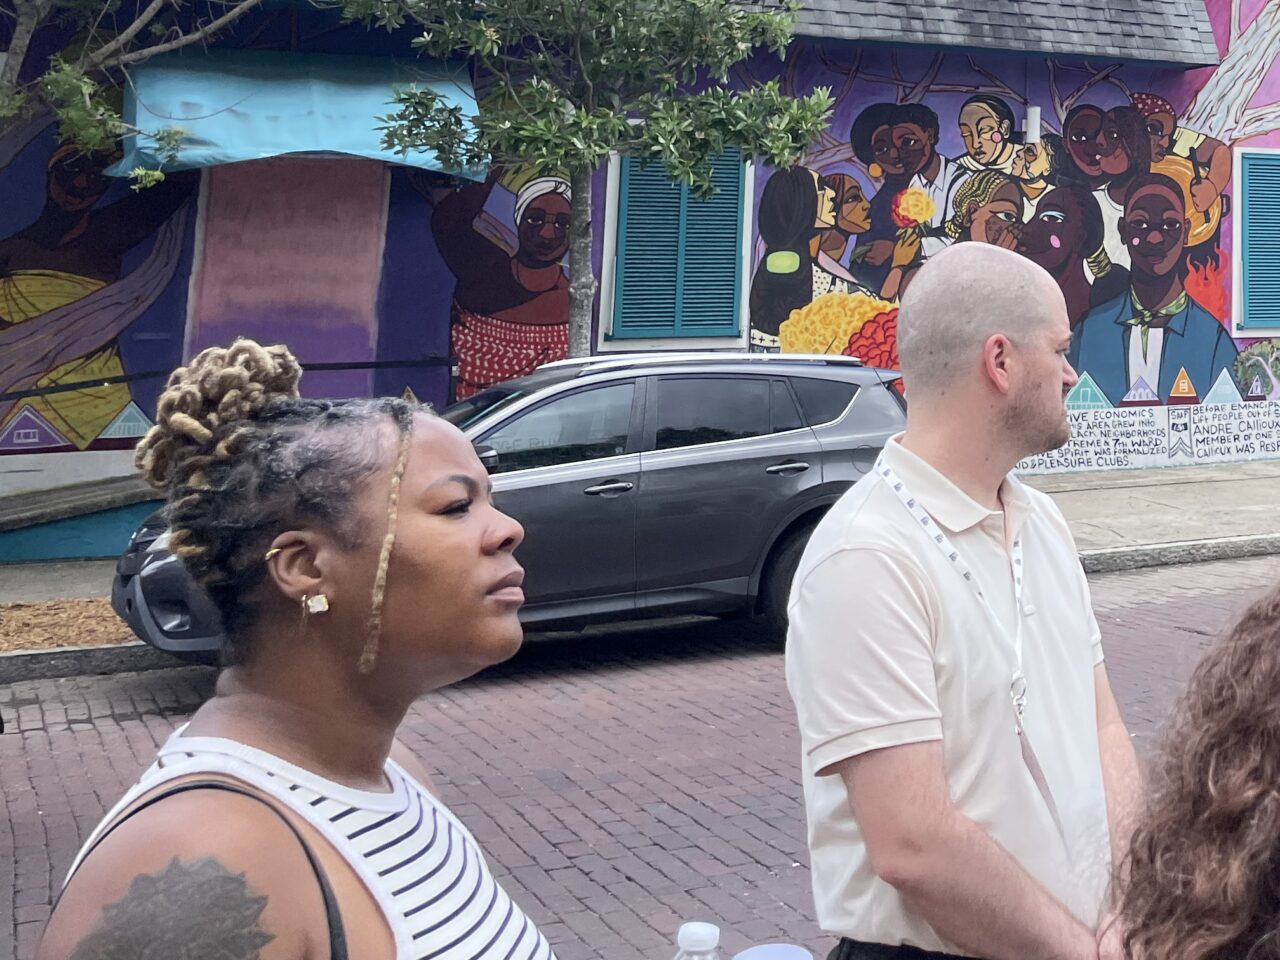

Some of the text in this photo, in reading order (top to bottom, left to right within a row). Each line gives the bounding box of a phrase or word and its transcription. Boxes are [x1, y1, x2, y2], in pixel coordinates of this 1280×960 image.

[1093, 408, 1154, 421] ECONOMICS
[1192, 404, 1227, 416] BEFORE
[1212, 411, 1243, 422] PEOPLE
[1086, 420, 1110, 430] AREA
[1111, 420, 1135, 429] GREW
[1193, 423, 1233, 436] ANDRE
[1100, 428, 1167, 439] NEIGHBORHOODS
[1195, 434, 1240, 448] MEMBER
[1255, 431, 1273, 440] ONE
[1131, 437, 1163, 448] WARD
[1235, 442, 1256, 454] WAS
[1057, 448, 1090, 458] SPIRIT
[1094, 448, 1112, 456] WAS
[1113, 446, 1168, 456] FORMALIZED
